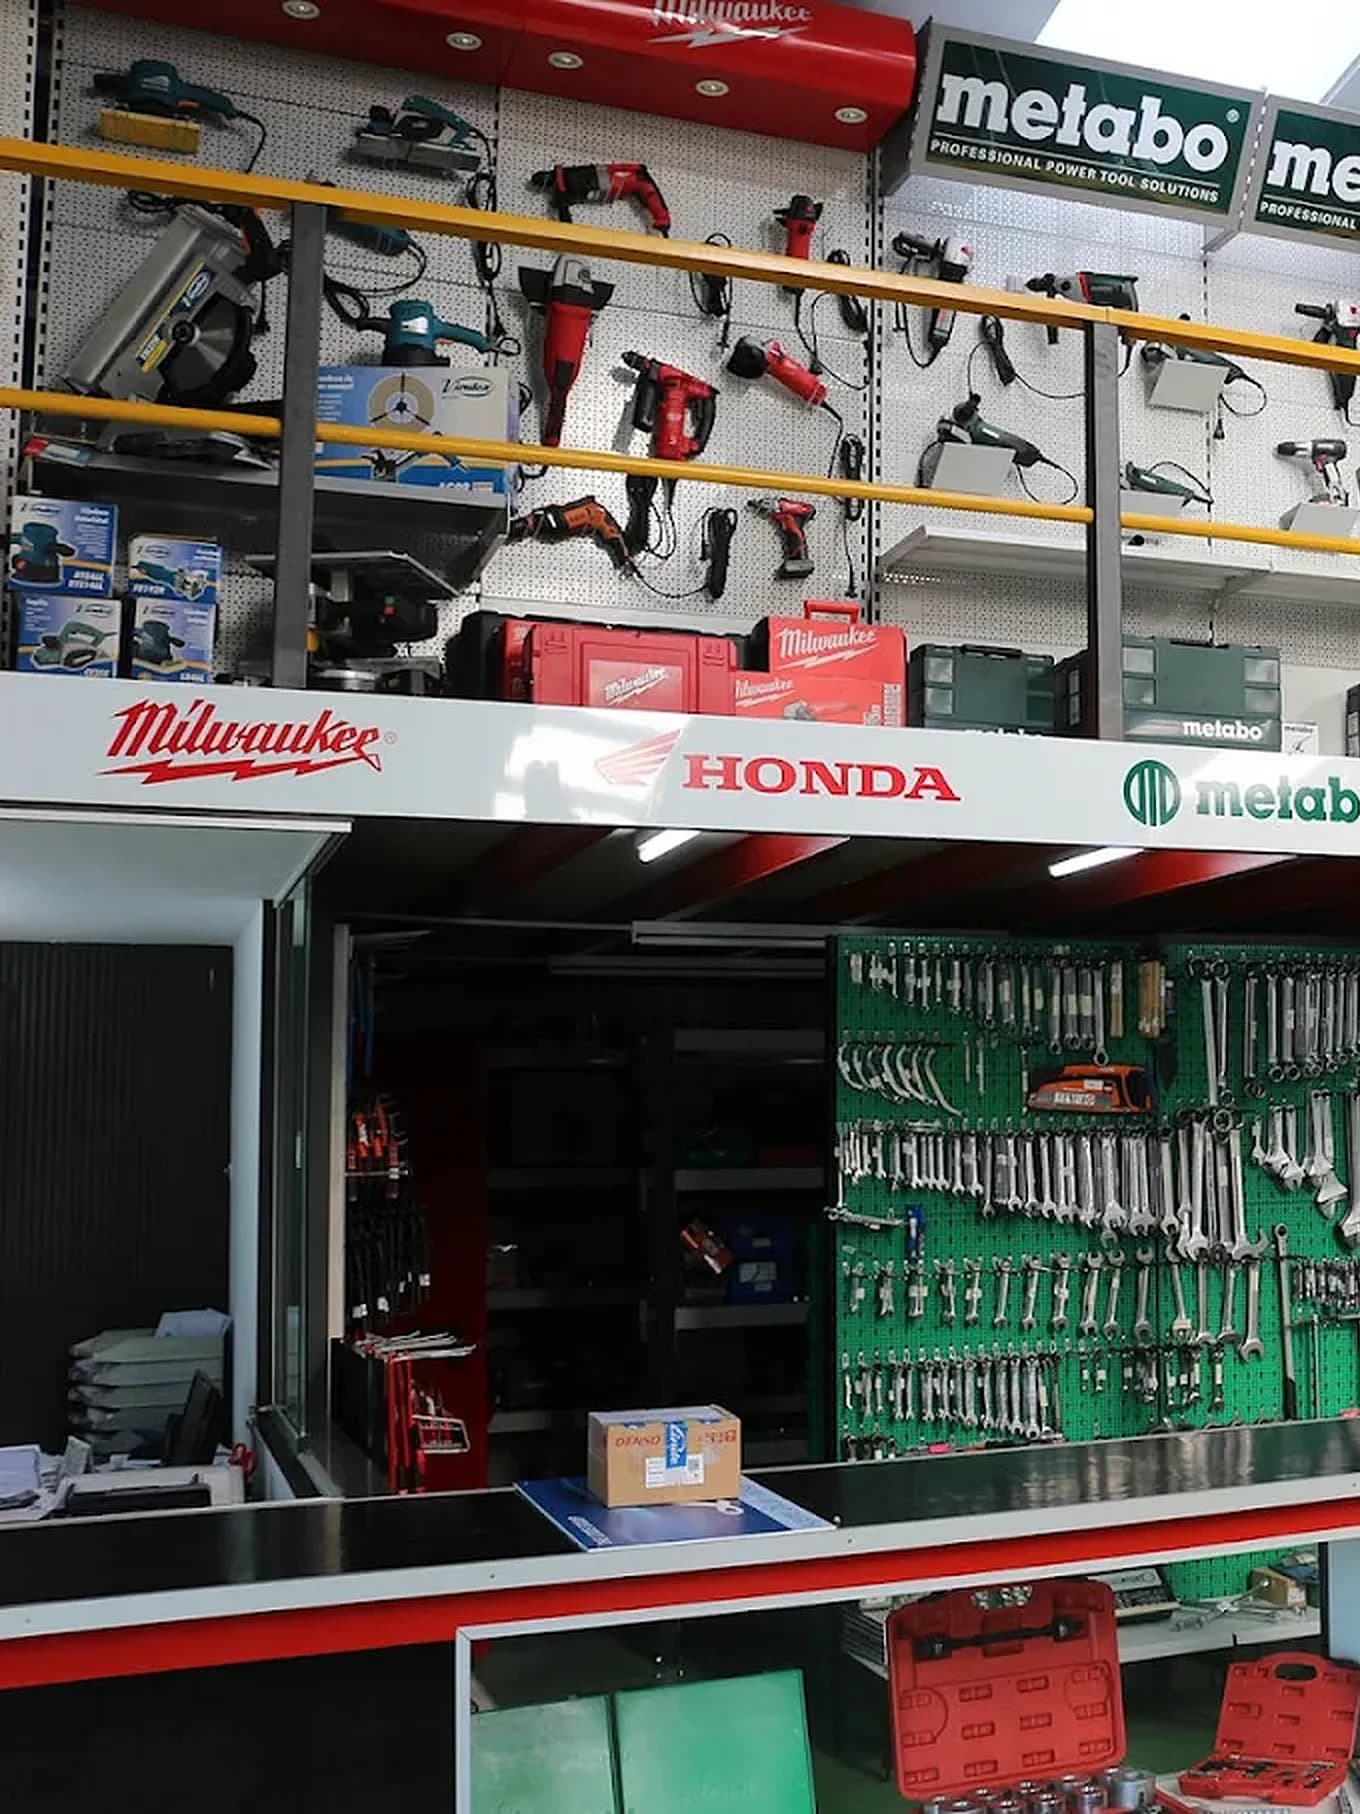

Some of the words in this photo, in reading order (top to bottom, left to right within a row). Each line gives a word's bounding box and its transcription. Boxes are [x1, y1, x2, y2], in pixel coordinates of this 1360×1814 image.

[936, 73, 1229, 172] metabo
[930, 139, 1041, 171] PROFESSIONAL
[1046, 160, 1096, 180] POWER
[1100, 170, 1135, 188] TOOL
[1139, 177, 1219, 203] SOLUTIONS
[1260, 201, 1357, 230] PROFESSIONAL
[779, 626, 877, 659] Milwaukee
[735, 678, 794, 698] ilwaukee
[107, 699, 381, 772] Milwaukee
[1183, 719, 1263, 742] metabo
[682, 753, 961, 801] HONDA
